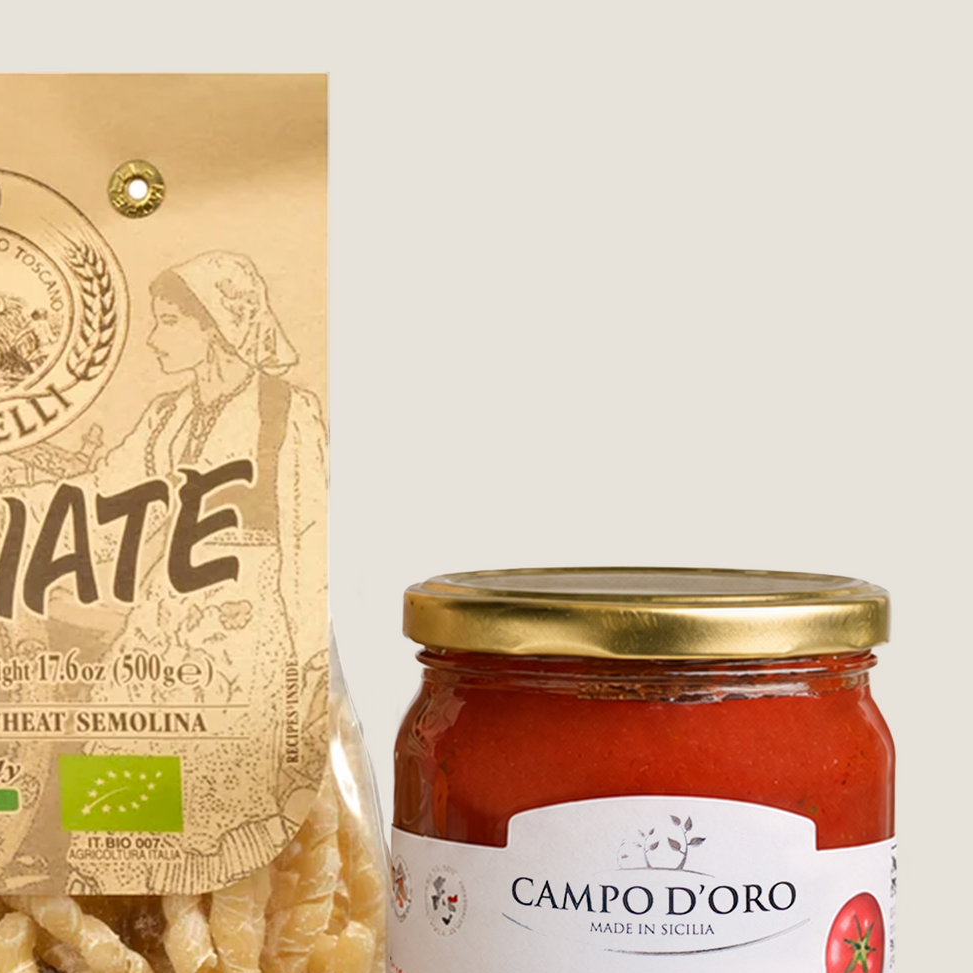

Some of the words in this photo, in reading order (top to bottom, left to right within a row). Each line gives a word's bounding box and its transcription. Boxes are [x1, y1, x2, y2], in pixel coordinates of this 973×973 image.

[15, 247, 65, 313] TOSCANO
[38, 650, 78, 682] 17.6
[82, 665, 106, 682] oz
[286, 660, 299, 704] INSIDE
[77, 711, 207, 733] SEMOLINA
[286, 711, 299, 763] RECIPES
[68, 848, 146, 860] AGRICOLTURA
[148, 848, 182, 860] ITALIA
[511, 877, 654, 915] CAMPO
[665, 881, 797, 916] D’ORO
[589, 922, 633, 935] MADE
[638, 923, 656, 935] IN
[661, 923, 715, 936] SICILIA
